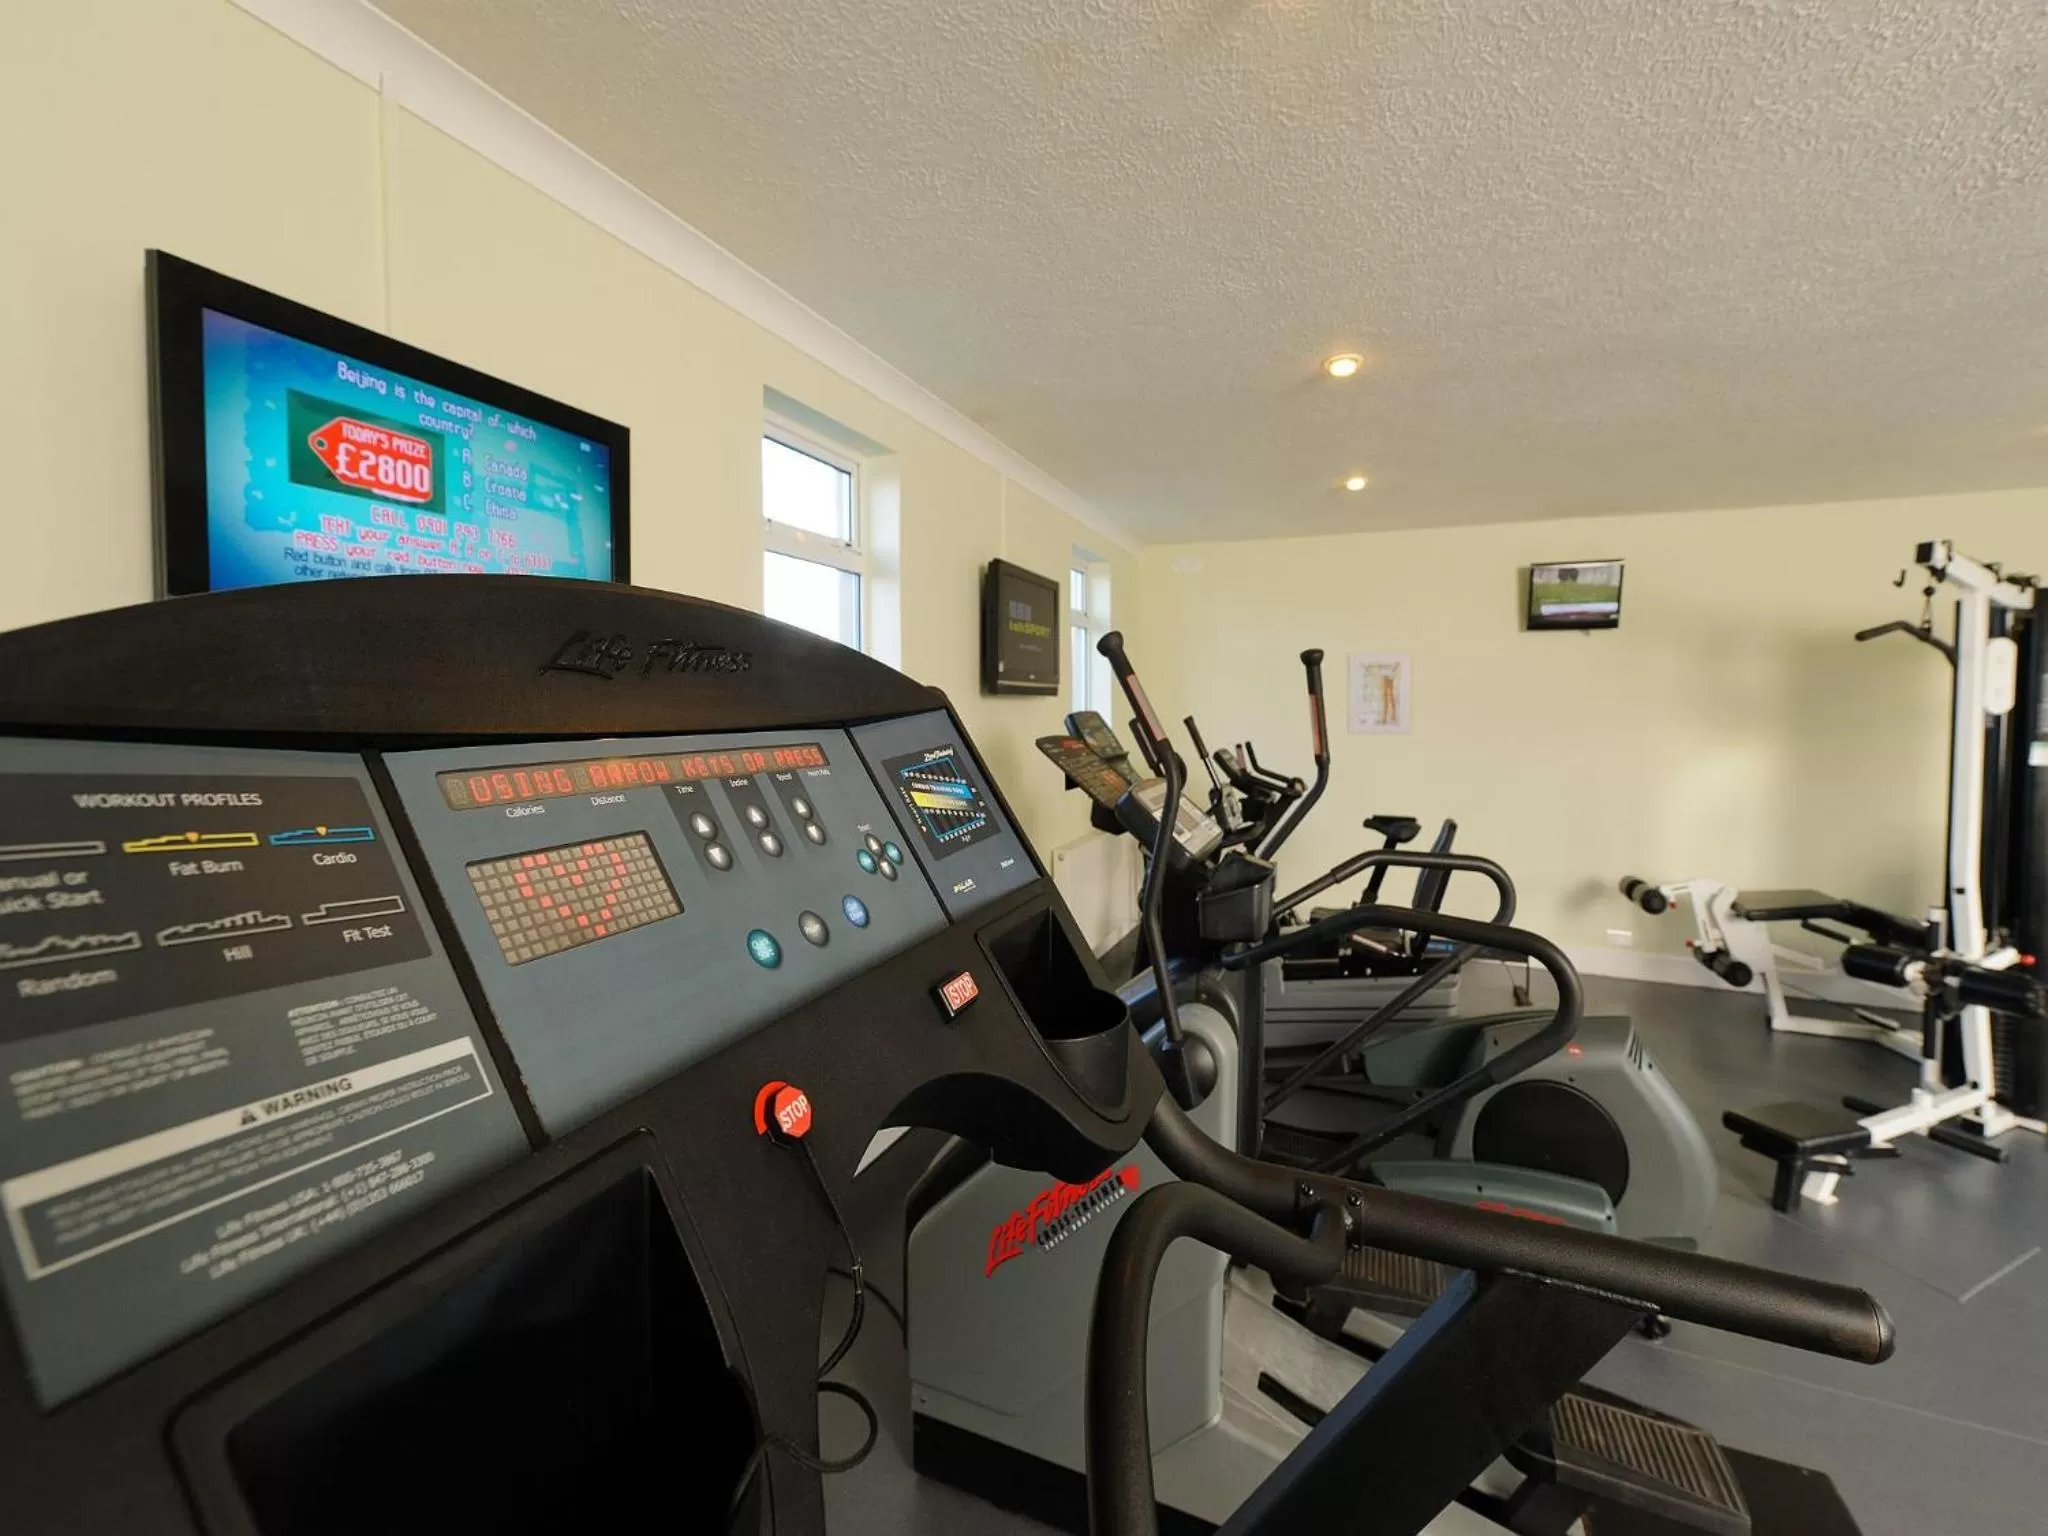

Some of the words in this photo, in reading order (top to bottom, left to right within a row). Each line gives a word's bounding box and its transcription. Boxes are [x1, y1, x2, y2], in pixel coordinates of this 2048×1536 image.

[336, 361, 387, 396] Beijing
[394, 385, 406, 399] is
[414, 389, 436, 409] the
[442, 399, 482, 423] capital
[487, 414, 502, 427] of
[506, 421, 536, 440] which
[342, 422, 390, 450] TODAY'S
[392, 435, 428, 460] PRIZE
[419, 412, 475, 440] country?
[335, 441, 430, 493] £2800
[319, 513, 351, 537] TEXT
[357, 526, 392, 543] your
[396, 534, 443, 551] answer
[370, 504, 409, 530] CALL
[283, 546, 308, 562] Red
[312, 552, 346, 567] button
[293, 529, 340, 553] PRESS
[345, 544, 378, 560] your
[384, 550, 411, 564] red
[417, 553, 458, 571] button
[638, 637, 753, 680] Fitness
[588, 757, 671, 790] ARROW
[773, 746, 826, 767] PRESS
[72, 793, 176, 809] WORKOUT
[181, 793, 263, 808] PROFILES
[505, 804, 546, 819] Calories
[590, 793, 627, 807] Distance
[168, 861, 201, 876] Fat
[202, 859, 244, 874] Burn
[312, 852, 357, 866] Cardio
[0, 870, 59, 892] anual
[63, 871, 89, 886] or
[0, 894, 44, 916] uick
[46, 890, 104, 909] Start
[342, 928, 364, 943] Fit
[362, 923, 394, 940] Test
[222, 944, 254, 962] Hill
[17, 969, 118, 999] Random
[948, 974, 974, 1005] STOP
[260, 1077, 353, 1116] WARNING
[778, 1093, 808, 1131] STOP
[1036, 1173, 1125, 1247] CROSS-TRAINER
[984, 1210, 1029, 1280] Life
